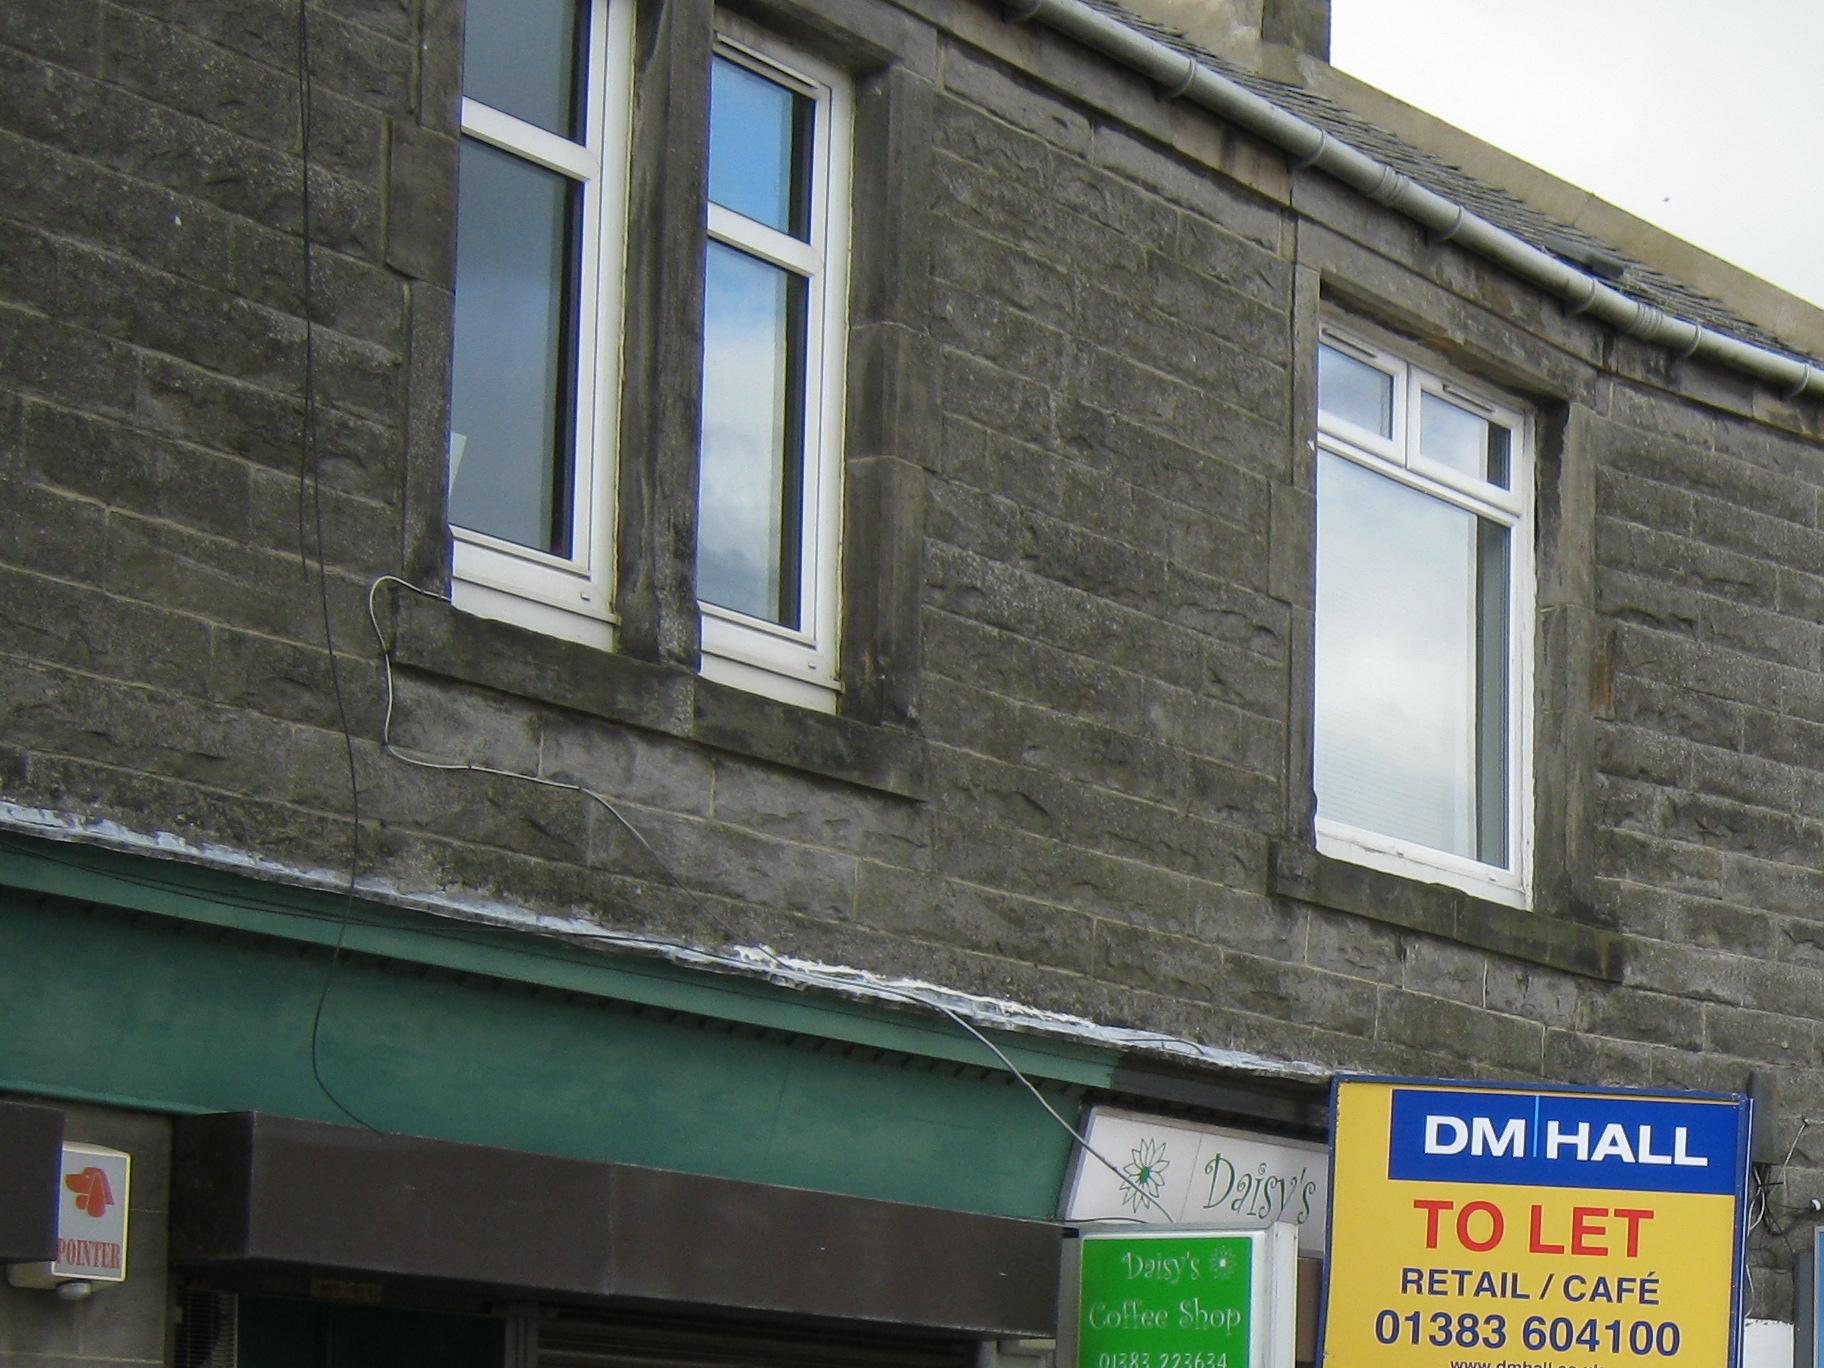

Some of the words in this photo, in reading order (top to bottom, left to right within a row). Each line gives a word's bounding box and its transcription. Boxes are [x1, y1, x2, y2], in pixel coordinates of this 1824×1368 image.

[1424, 1115, 1526, 1158] DM
[1546, 1121, 1708, 1167] HALL
[1202, 1152, 1316, 1225] Daisy's
[1413, 1199, 1505, 1252] TO
[1529, 1204, 1655, 1258] LET
[56, 1238, 121, 1269] POINTER
[1121, 1251, 1200, 1283] Daisy's
[1401, 1267, 1530, 1299] RETAIL
[1563, 1271, 1661, 1305] CAFÉ
[1089, 1299, 1168, 1330] Coffee
[1179, 1297, 1242, 1336] Shop
[1375, 1309, 1507, 1350] 01383
[1522, 1317, 1681, 1357] 604100
